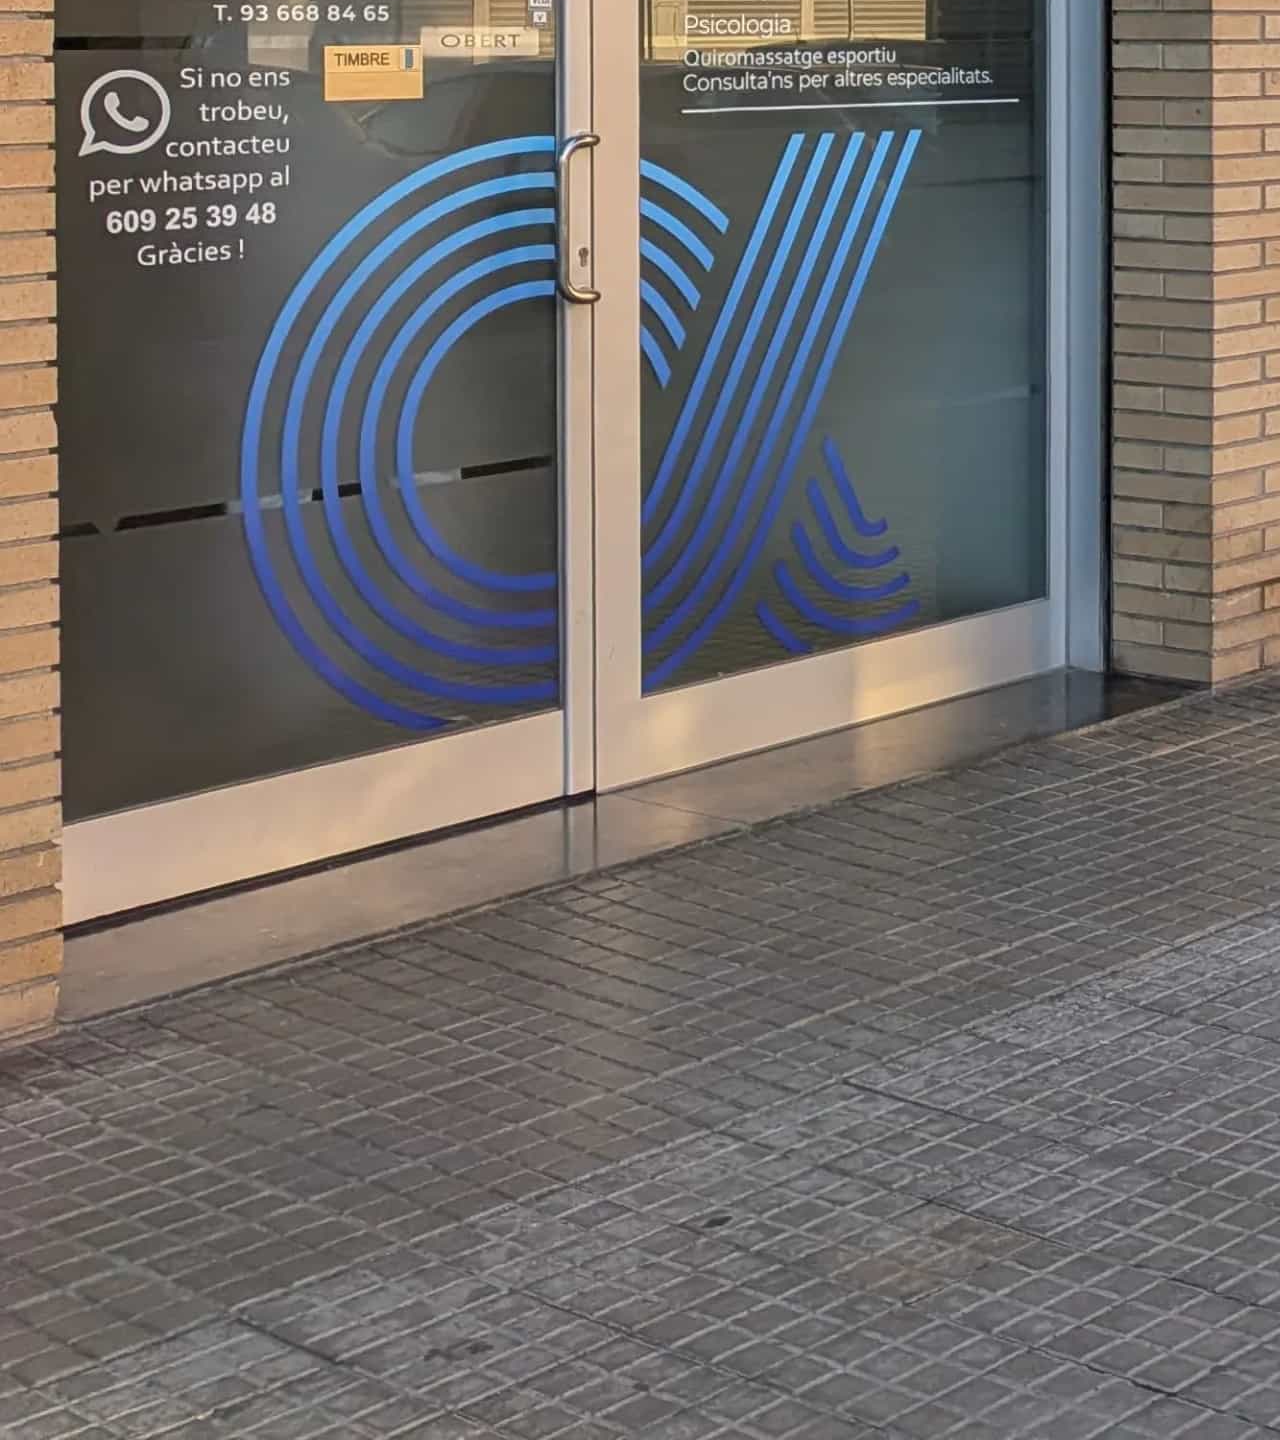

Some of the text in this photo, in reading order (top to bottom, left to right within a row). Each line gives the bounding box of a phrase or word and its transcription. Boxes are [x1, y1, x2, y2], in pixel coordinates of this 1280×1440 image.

[213, 3, 390, 23] T. 93 668 84 65
[684, 14, 791, 37] Psicologia
[440, 33, 521, 49] OBERT
[334, 52, 391, 67] TIMBRE
[683, 47, 896, 70] Quiromassatge esportiu
[180, 67, 290, 89] Si no ens
[683, 68, 993, 92] Consulta'ns per altres especialitats.
[199, 101, 289, 125] trobeu,
[165, 136, 290, 158] contacteu
[89, 167, 290, 201] per whatsapp al
[106, 202, 276, 235] 609 25 39 48
[137, 243, 231, 267] Gràcies
